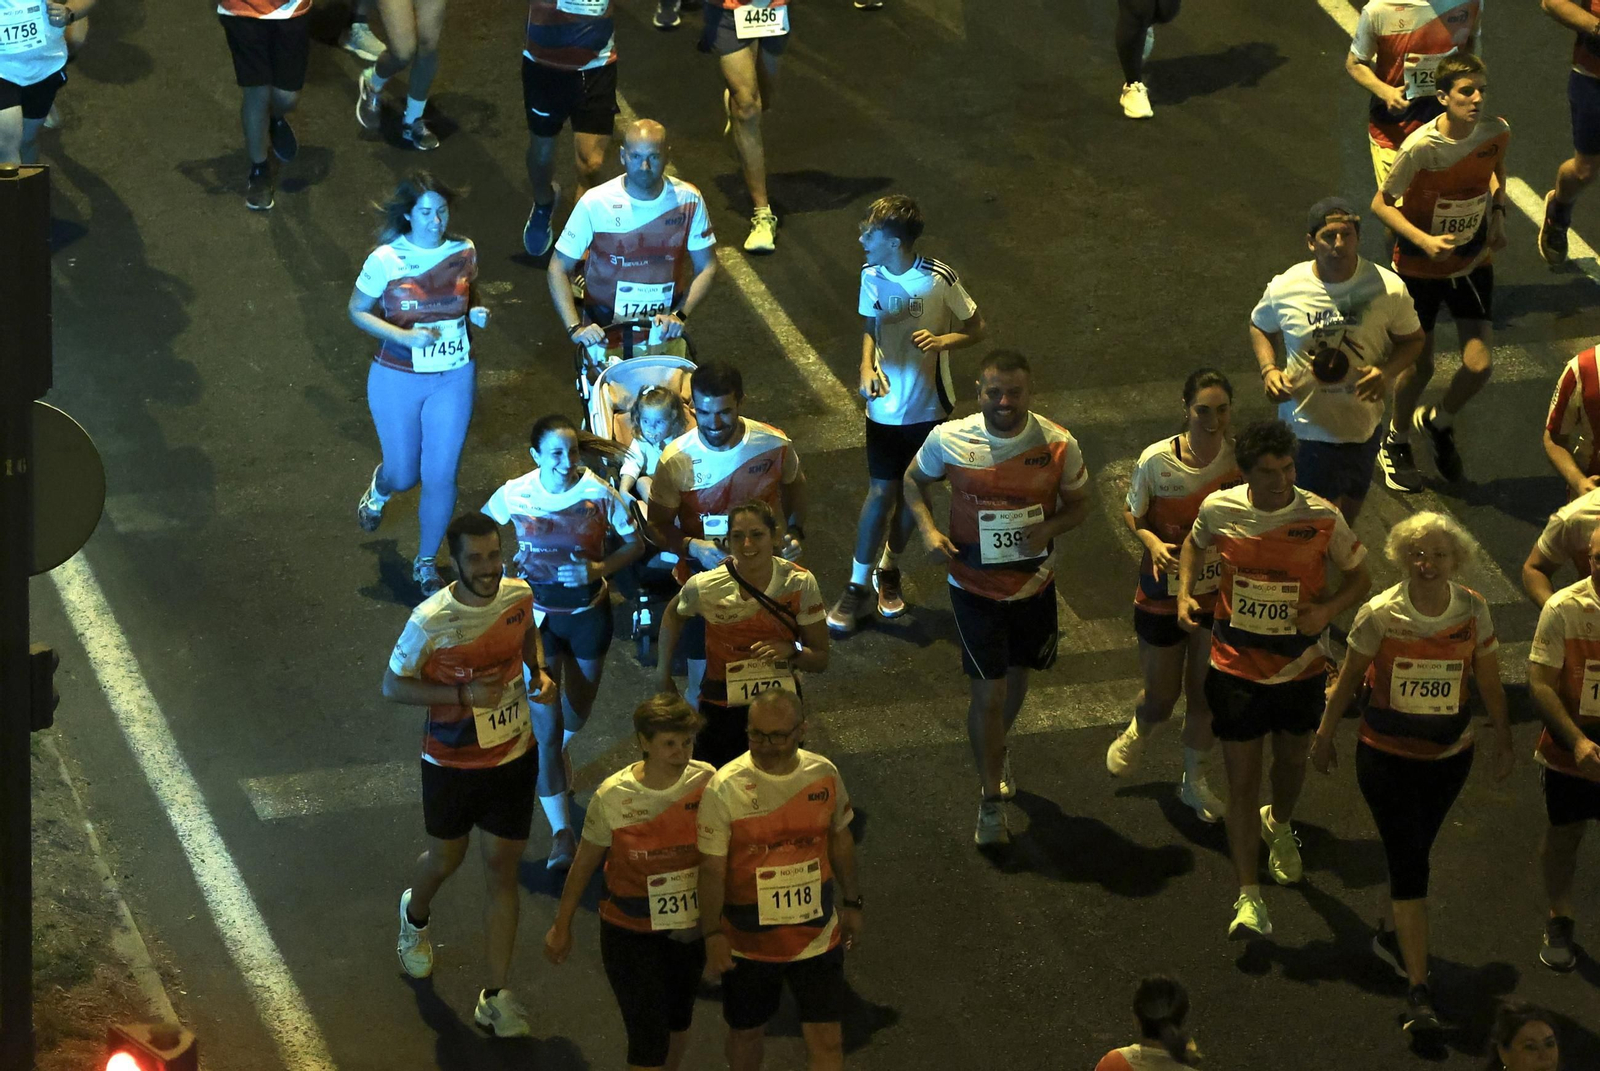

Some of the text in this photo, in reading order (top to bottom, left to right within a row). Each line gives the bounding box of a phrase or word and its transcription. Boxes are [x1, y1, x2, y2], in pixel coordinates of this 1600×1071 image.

[745, 9, 777, 24] 4456
[0, 22, 38, 41] 1758
[1439, 214, 1480, 233] 18845
[400, 300, 419, 311] 37
[622, 303, 665, 318] 17459
[422, 339, 464, 358] 17454
[518, 540, 533, 552] 37
[1238, 598, 1289, 621] 24708
[1400, 681, 1452, 698] 17580
[488, 703, 520, 730] 1477
[685, 801, 701, 811] KH
[657, 890, 699, 915] 2311
[772, 886, 813, 909] 1118
